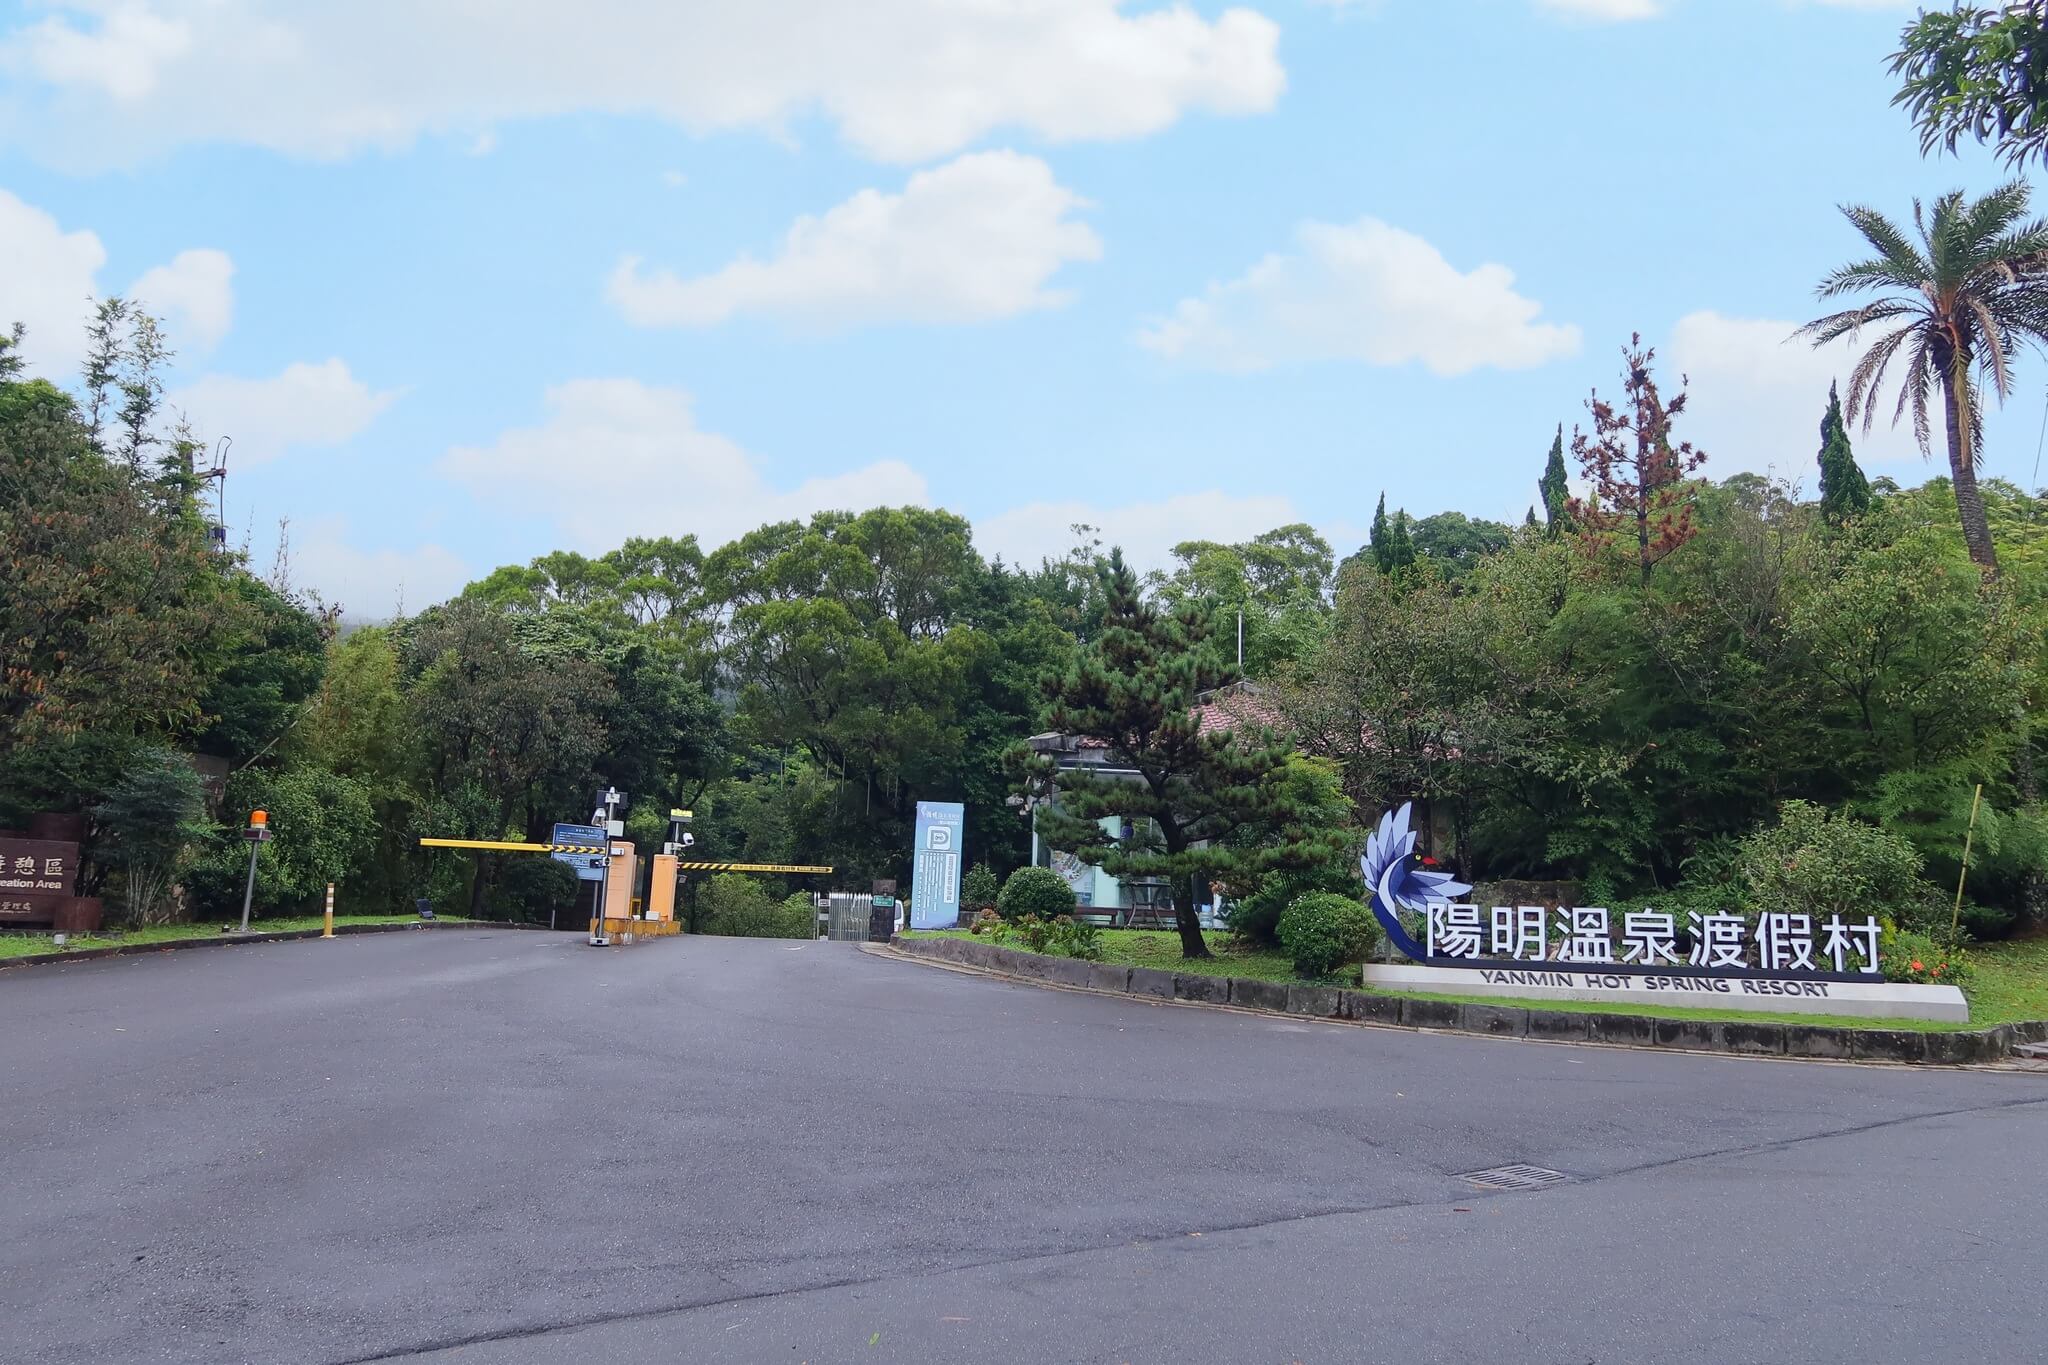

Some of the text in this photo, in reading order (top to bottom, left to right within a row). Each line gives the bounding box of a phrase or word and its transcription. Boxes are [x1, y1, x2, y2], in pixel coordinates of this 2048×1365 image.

[36, 880, 62, 889] Area
[1426, 903, 1882, 973] 陽明溫泉渡假村
[1480, 969, 1829, 998] YANMIN HOT SPRING RESORT
